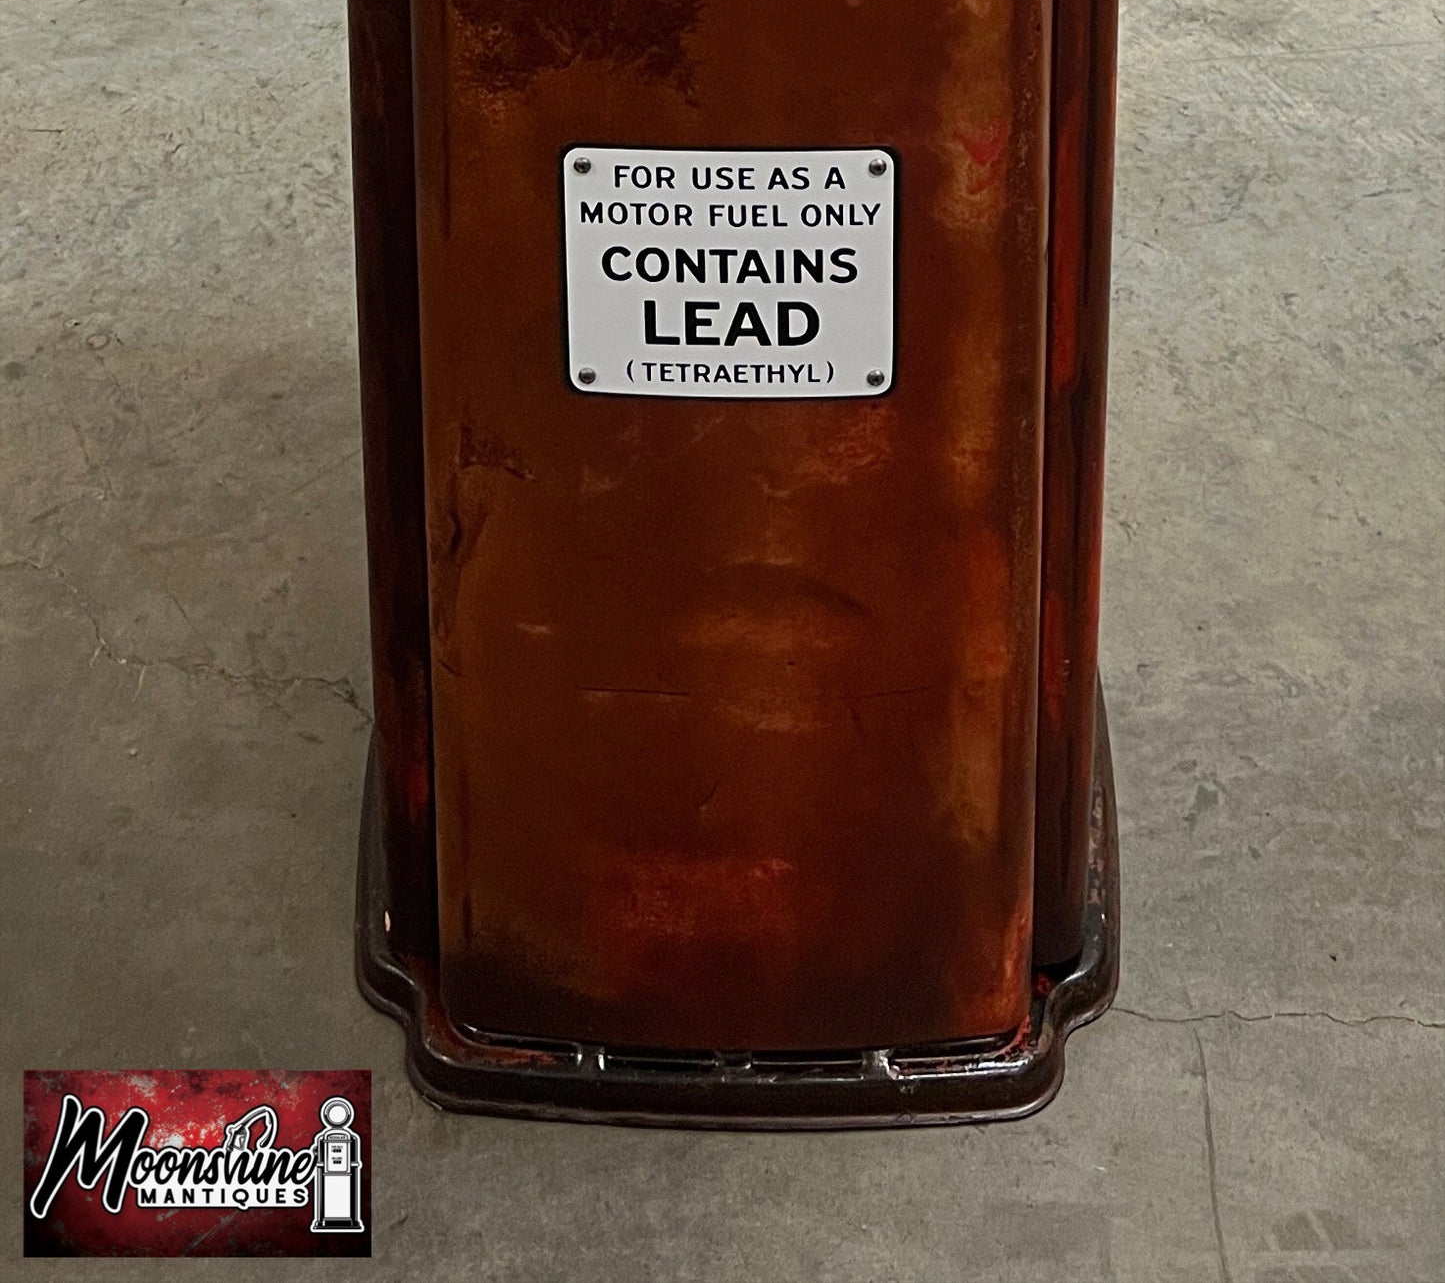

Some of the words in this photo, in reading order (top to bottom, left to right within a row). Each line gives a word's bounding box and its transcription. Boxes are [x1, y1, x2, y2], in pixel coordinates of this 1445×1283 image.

[614, 164, 676, 190] FOR
[691, 166, 756, 191] USE
[767, 166, 810, 191] AS
[824, 166, 846, 190] A
[580, 201, 693, 227] MOTOR
[709, 204, 788, 228] FUEL
[800, 203, 881, 228] ONLY
[601, 246, 858, 284] CONTAINS
[643, 299, 820, 347] LEAD
